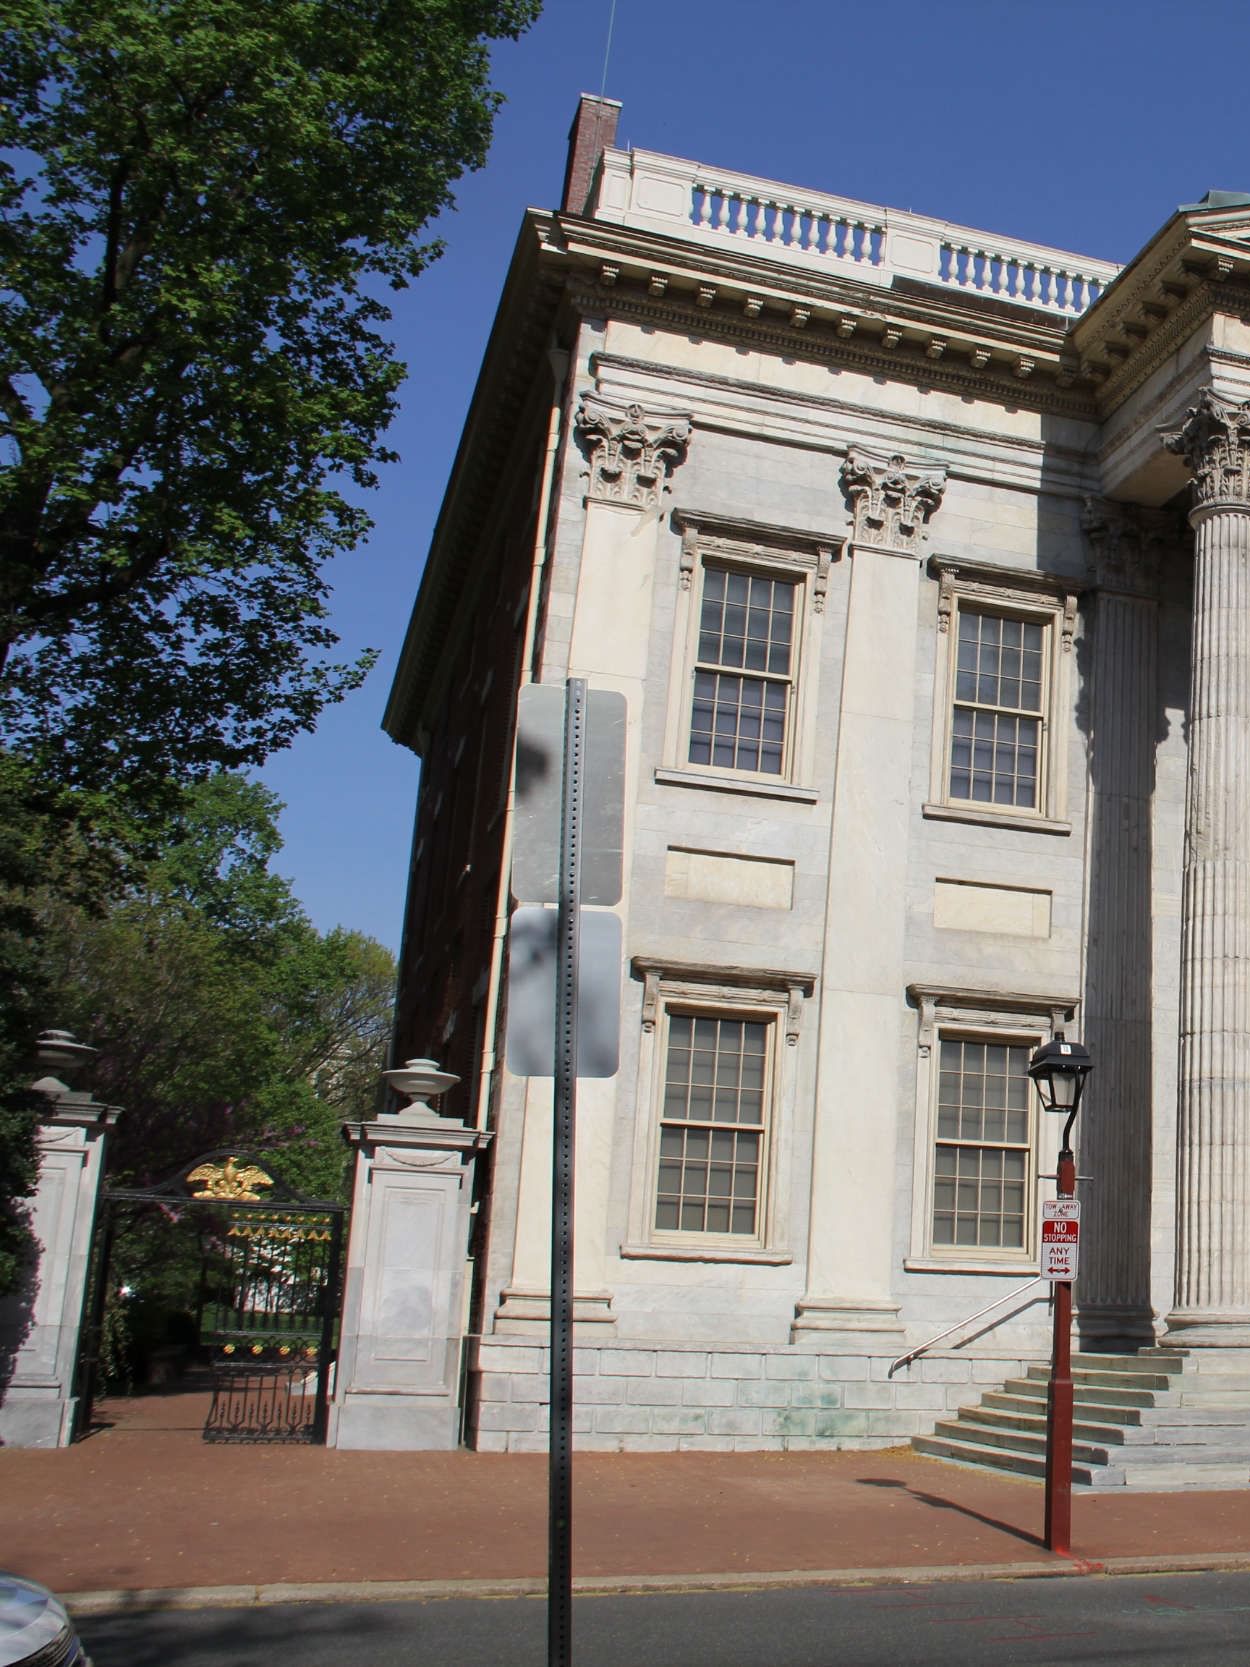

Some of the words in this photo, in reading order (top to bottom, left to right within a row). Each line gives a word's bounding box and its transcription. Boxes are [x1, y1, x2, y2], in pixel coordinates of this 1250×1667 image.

[1053, 1222, 1067, 1233] NO
[1044, 1234, 1076, 1242] STOPPING
[1049, 1247, 1070, 1255] ANY
[1049, 1256, 1070, 1264] TIME
